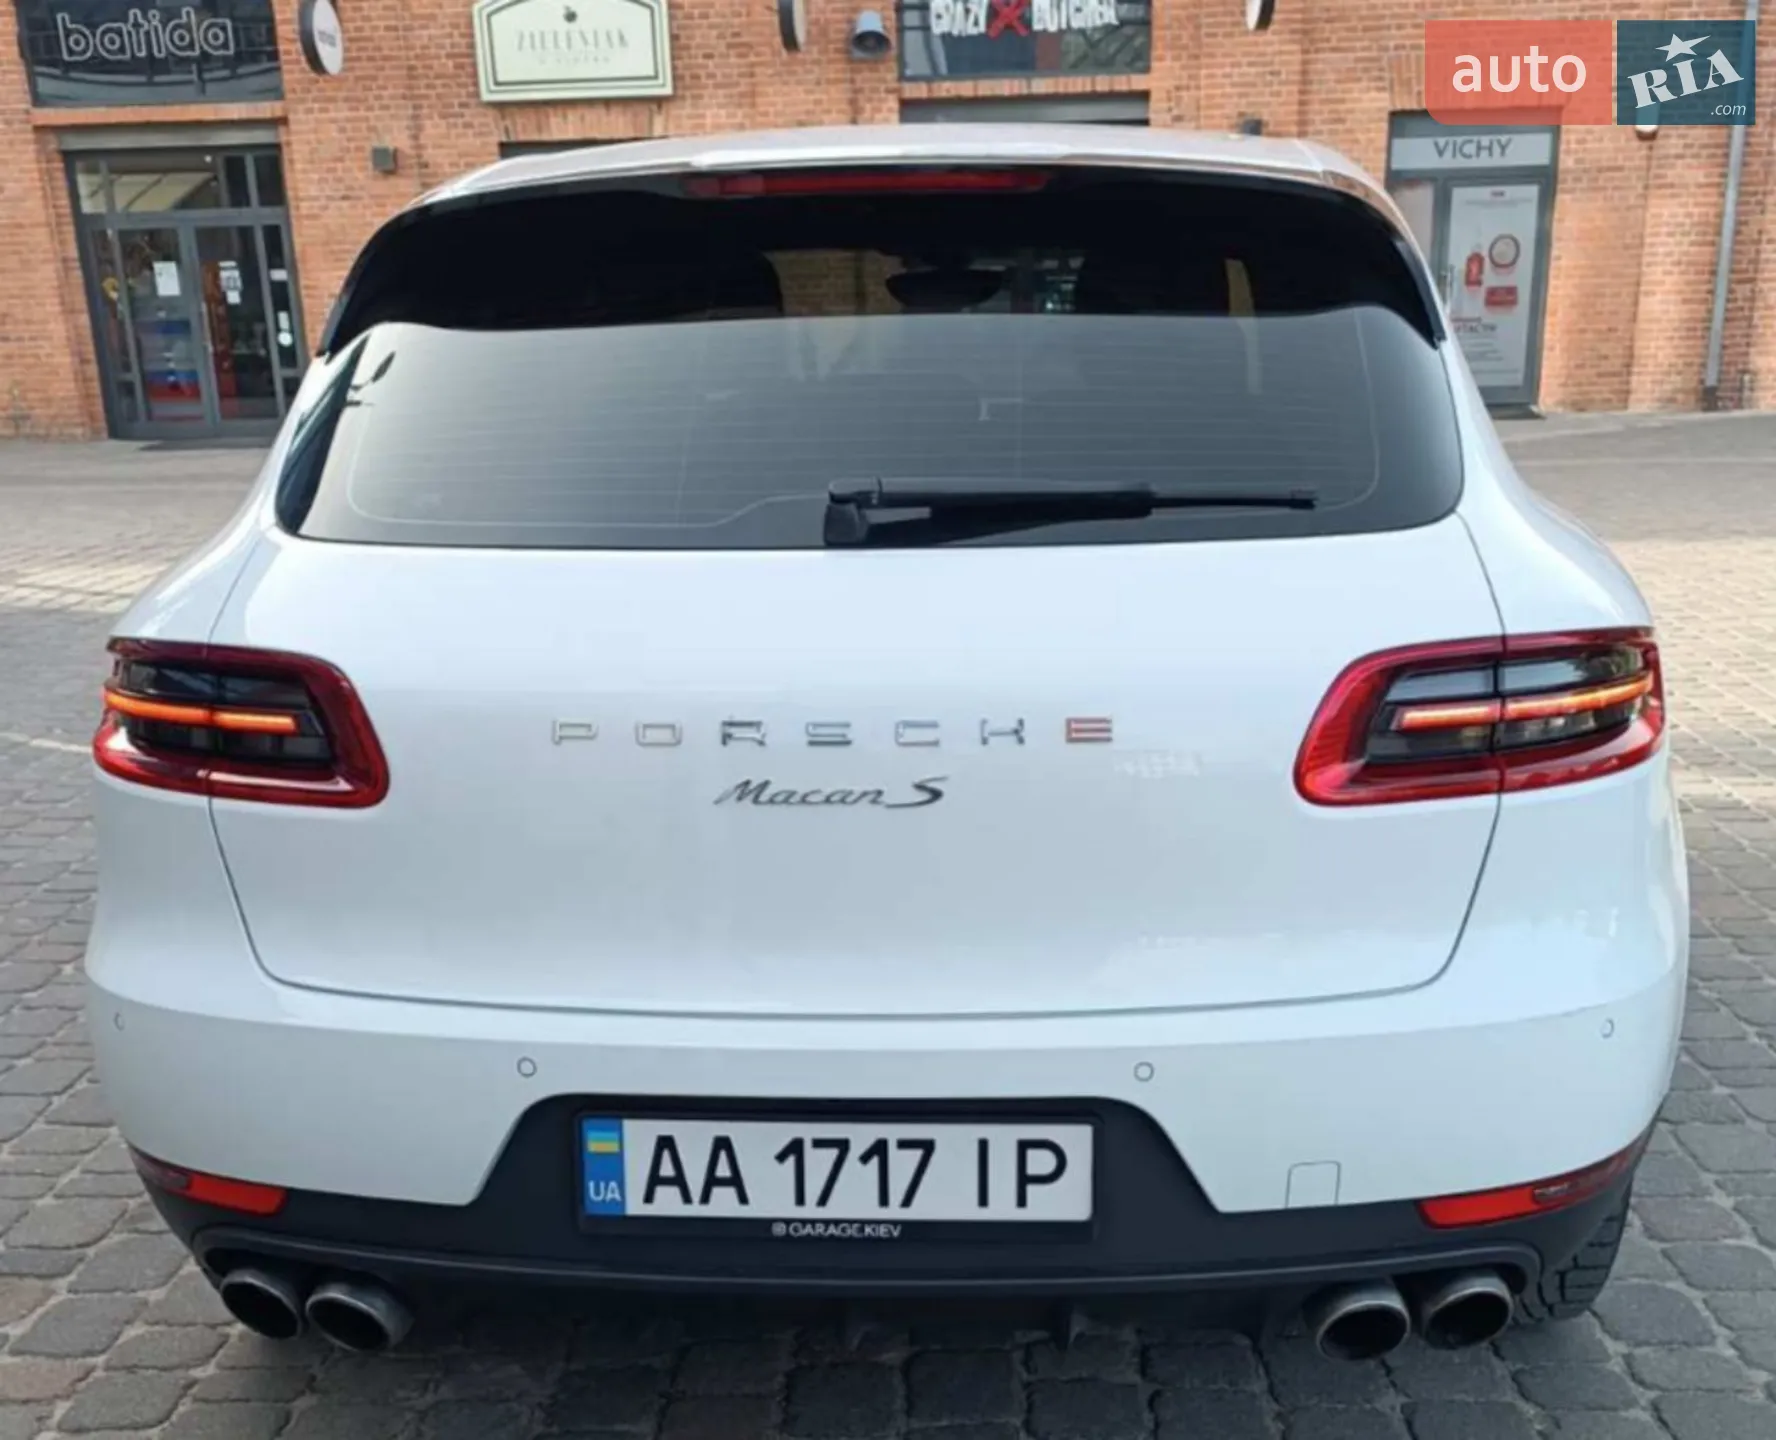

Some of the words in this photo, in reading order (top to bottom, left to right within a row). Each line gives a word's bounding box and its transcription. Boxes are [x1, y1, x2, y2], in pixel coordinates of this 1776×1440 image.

[56, 6, 235, 61] batida
[1433, 137, 1513, 159] VICHY
[552, 717, 1113, 747] PORSCHE
[712, 778, 885, 806] Macan
[884, 775, 949, 809] S
[642, 1134, 750, 1206] AA
[773, 1136, 936, 1208] 1717
[977, 1137, 1068, 1209] IP
[589, 1181, 622, 1202] UA
